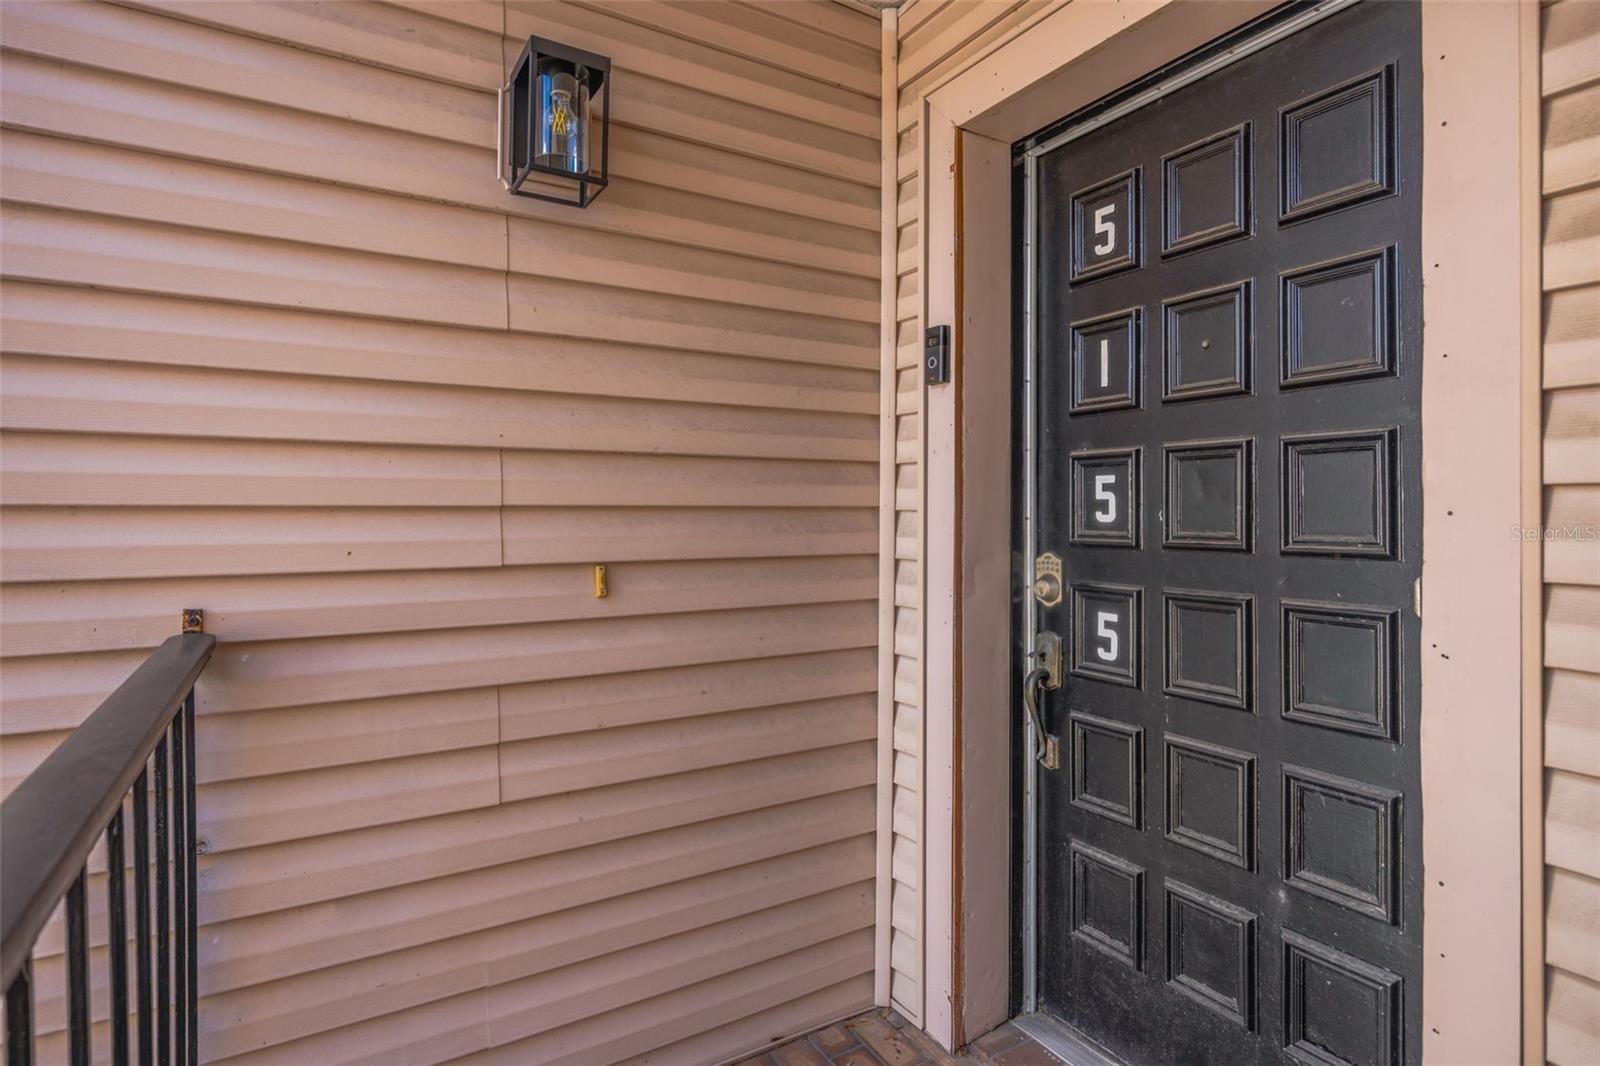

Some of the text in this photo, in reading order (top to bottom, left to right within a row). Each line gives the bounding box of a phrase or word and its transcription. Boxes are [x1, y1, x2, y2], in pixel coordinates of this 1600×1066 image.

[1094, 203, 1116, 256] 5
[1095, 474, 1117, 523] 5
[1097, 611, 1119, 662] 5
